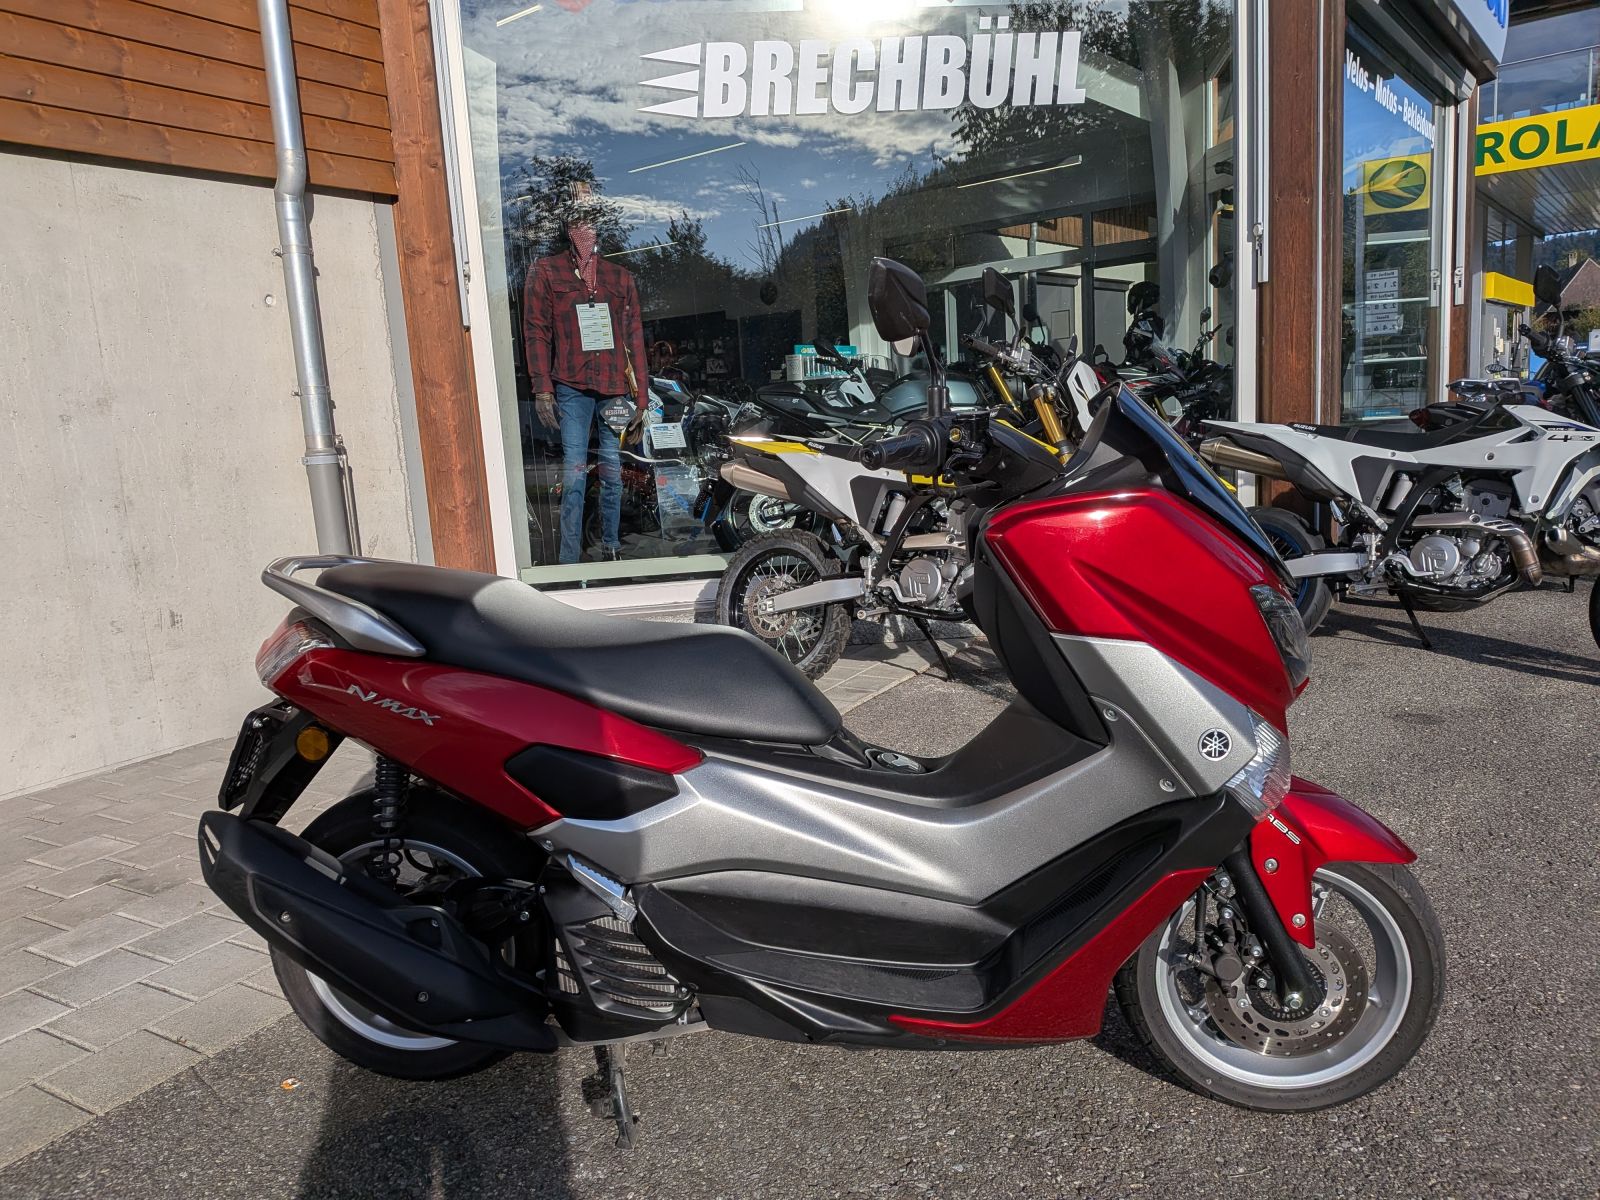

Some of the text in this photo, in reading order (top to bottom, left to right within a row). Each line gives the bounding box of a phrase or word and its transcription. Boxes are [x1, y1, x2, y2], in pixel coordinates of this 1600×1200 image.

[703, 16, 1086, 118] BRECHBÜHL
[1346, 48, 1369, 93] Velos
[1375, 74, 1398, 115] Motos
[1403, 97, 1436, 149] Bekleidung
[1293, 423, 1317, 431] SUZUKI
